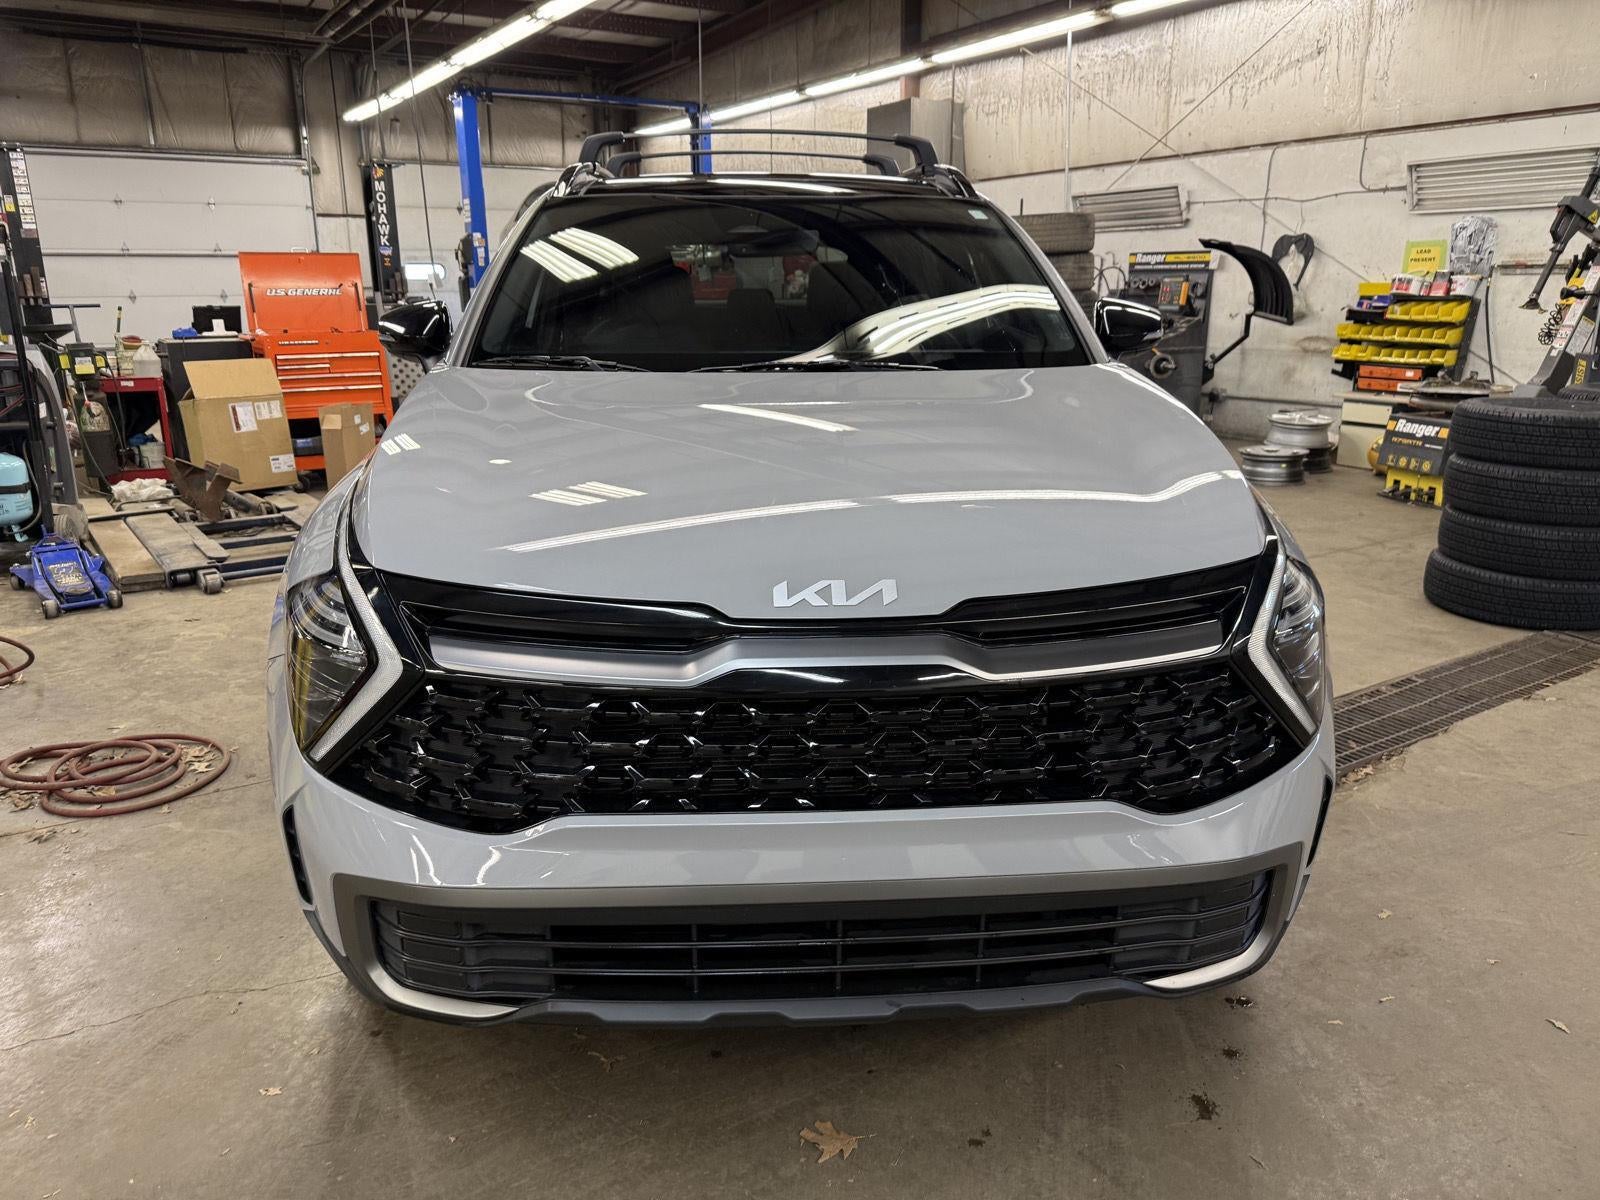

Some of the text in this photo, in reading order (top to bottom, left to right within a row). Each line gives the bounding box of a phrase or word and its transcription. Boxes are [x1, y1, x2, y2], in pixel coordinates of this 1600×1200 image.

[374, 180, 390, 246] MOHAWK
[1135, 253, 1166, 264] Ranger
[288, 288, 342, 296] GENERAL
[1395, 418, 1440, 437] Ranger
[773, 579, 898, 607] KIA
